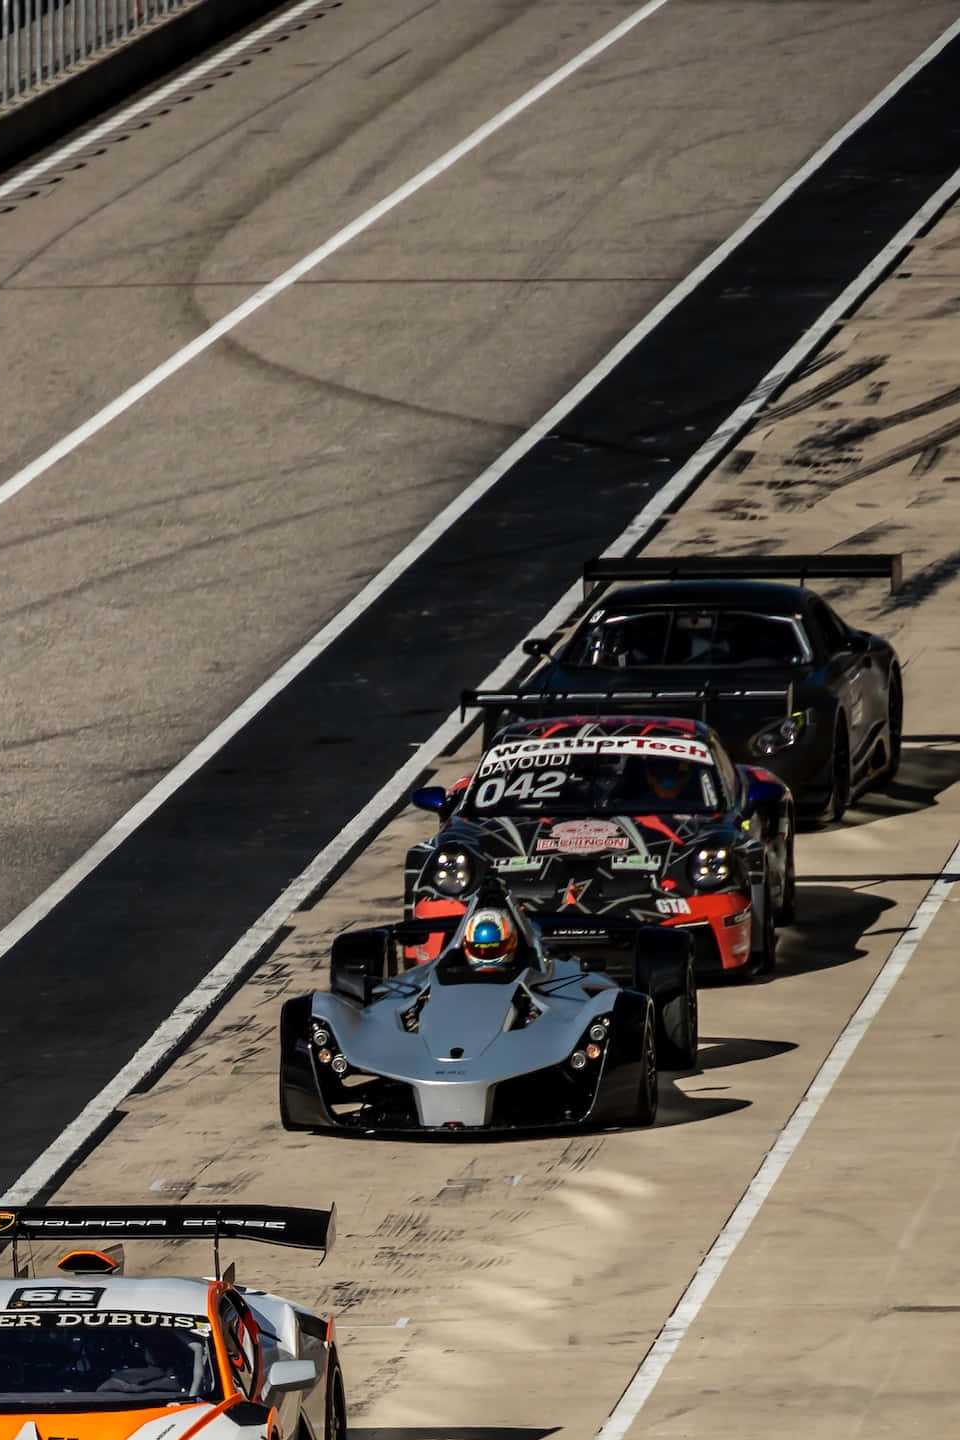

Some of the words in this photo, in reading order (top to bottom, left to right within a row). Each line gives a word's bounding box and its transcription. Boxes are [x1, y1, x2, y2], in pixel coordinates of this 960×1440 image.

[493, 738, 708, 759] WeatherTech
[479, 753, 572, 778] DAVOUDI
[475, 770, 567, 809] 042
[656, 898, 691, 914] GTA
[23, 1219, 167, 1227] SQUADRA
[56, 1313, 195, 1329] DUBUIS
